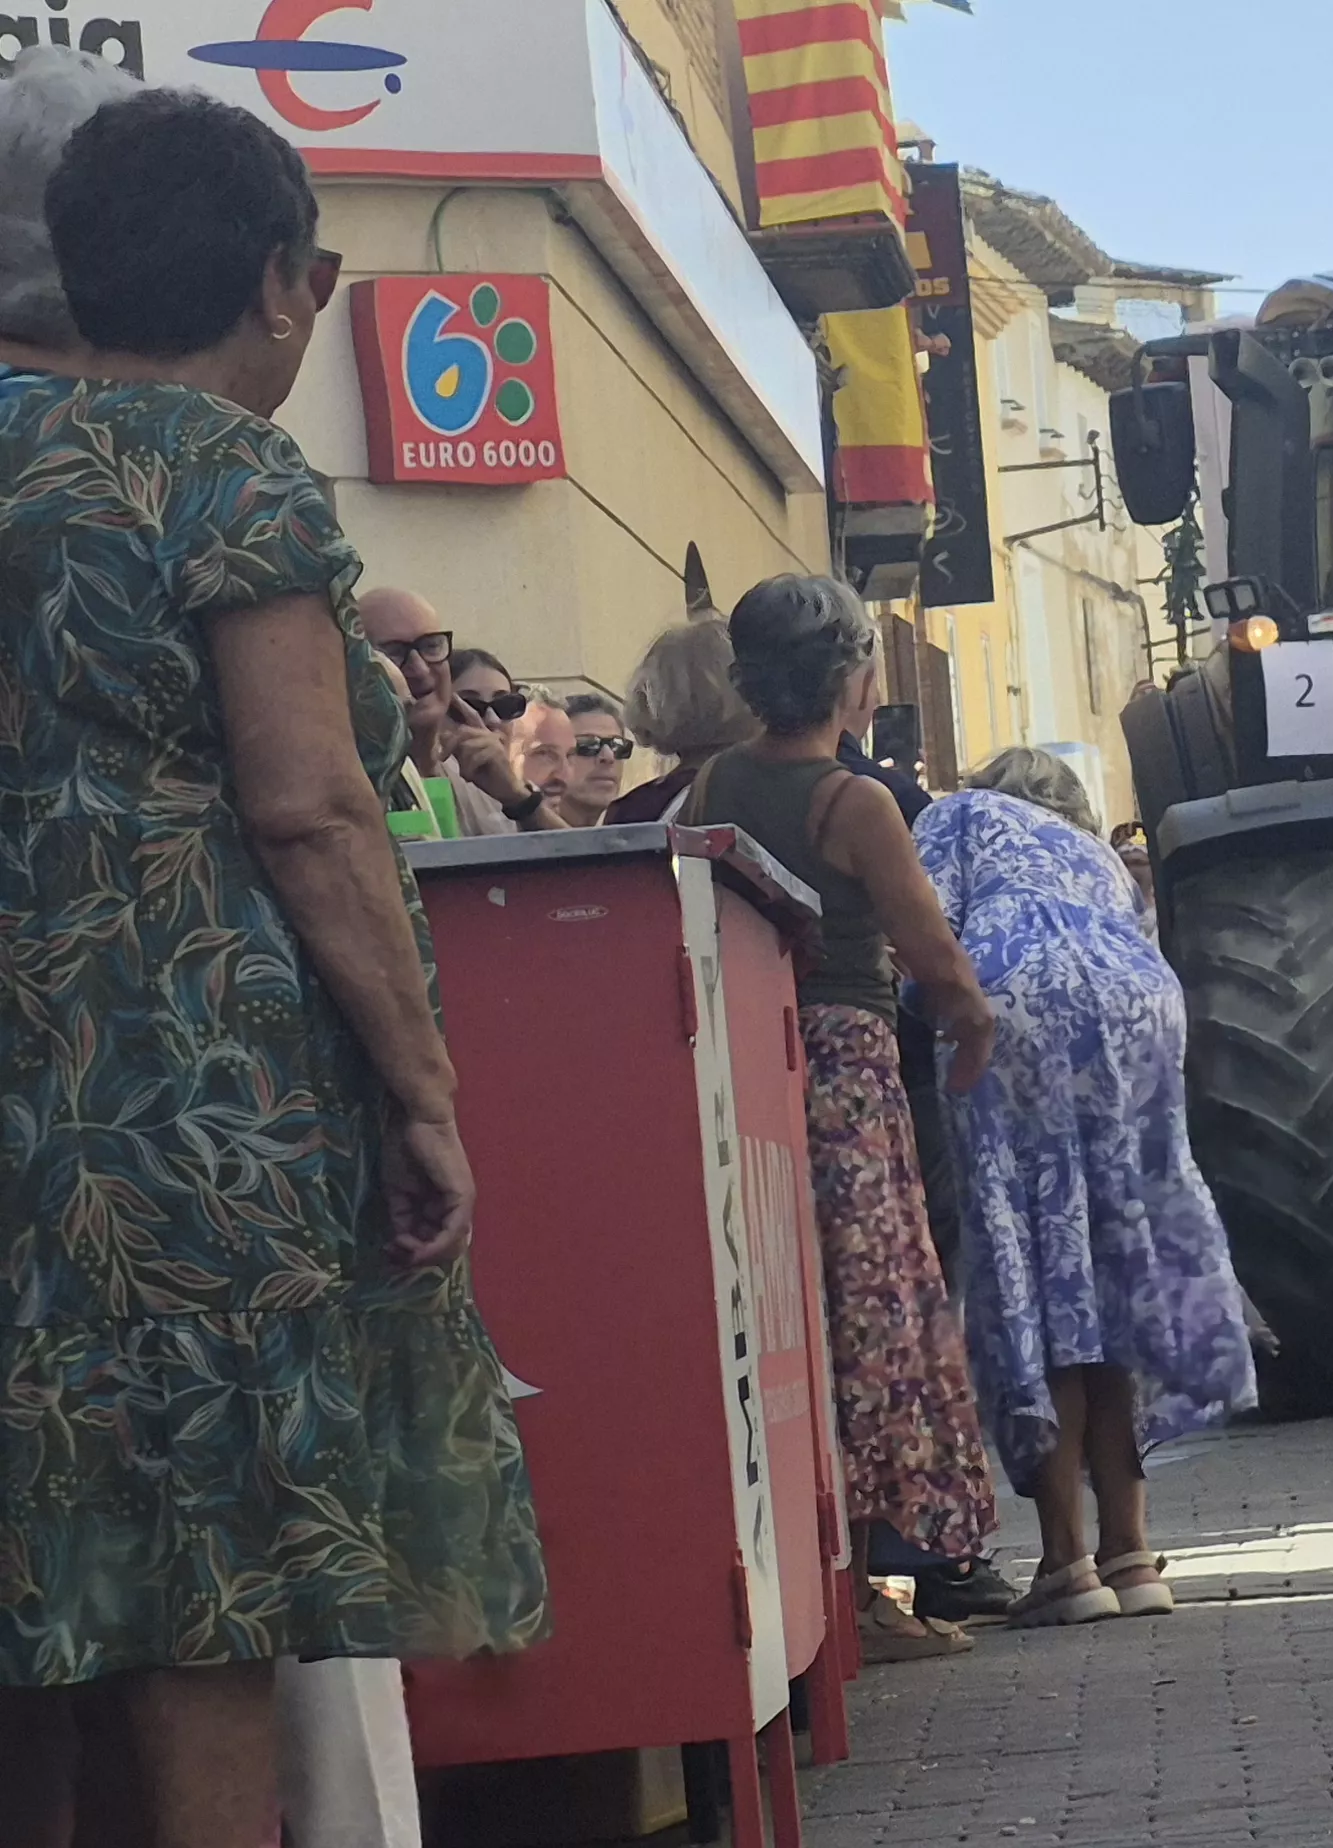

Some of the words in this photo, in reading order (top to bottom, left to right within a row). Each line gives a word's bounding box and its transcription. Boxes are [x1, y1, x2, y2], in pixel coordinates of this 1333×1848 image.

[402, 441, 476, 468] EURO
[483, 440, 555, 468] 6000
[1295, 674, 1315, 708] 2
